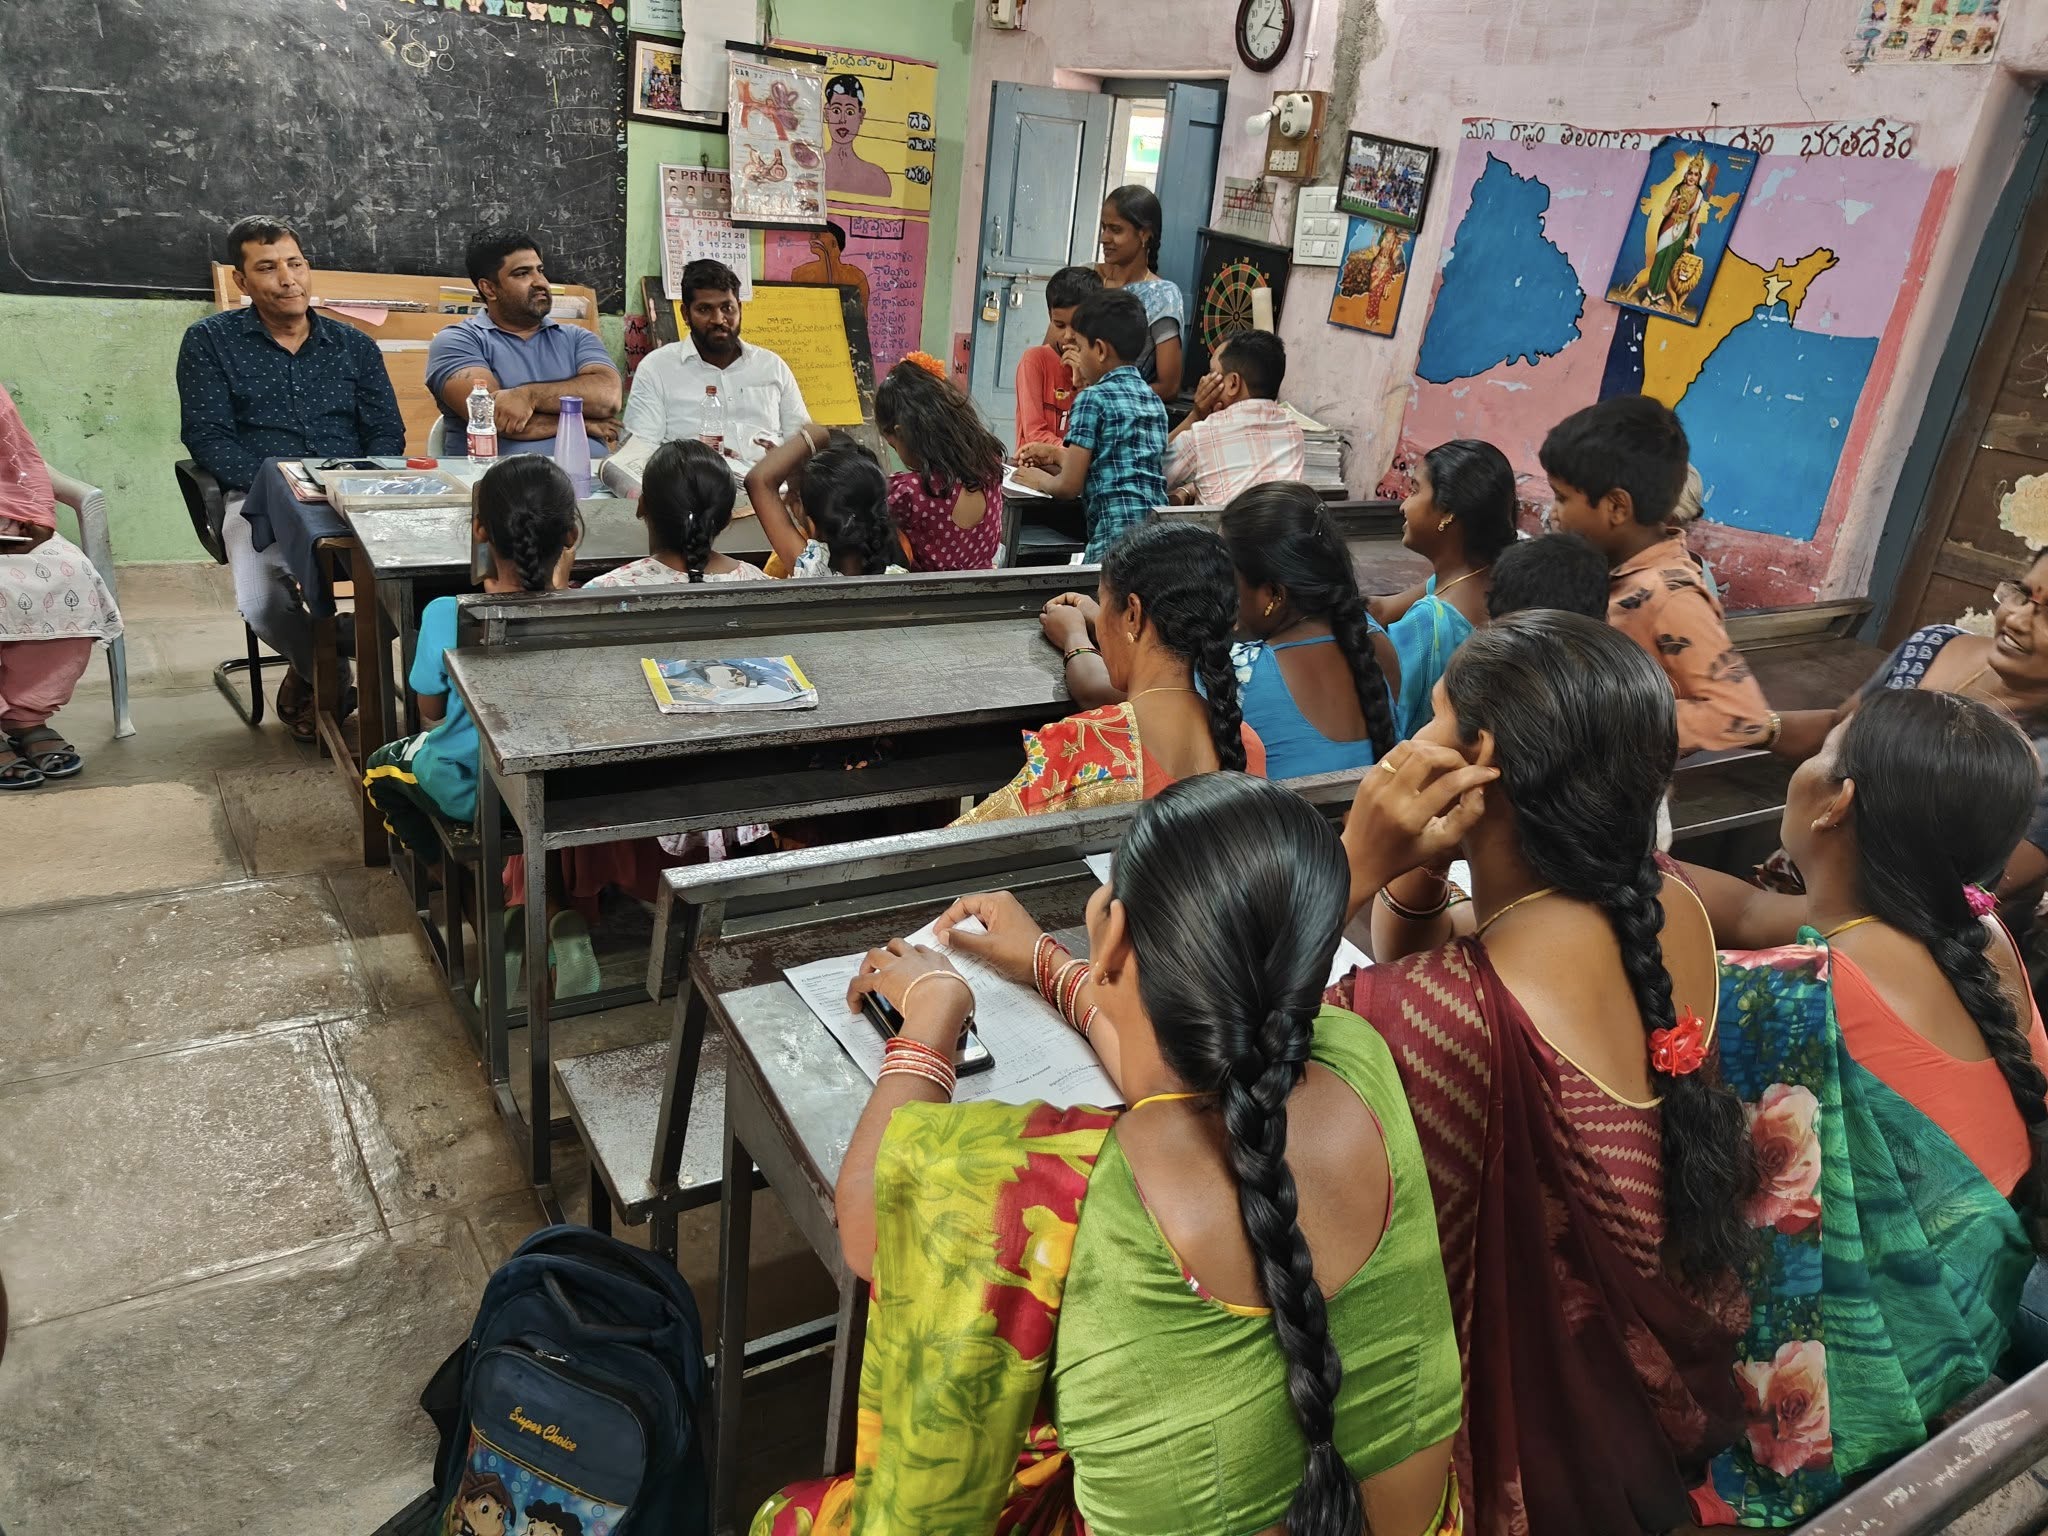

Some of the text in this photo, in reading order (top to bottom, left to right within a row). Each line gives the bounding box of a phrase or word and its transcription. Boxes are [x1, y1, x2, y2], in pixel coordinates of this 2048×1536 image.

[735, 68, 750, 77] EAR
[1466, 122, 1495, 141] మన
[696, 210, 717, 218] 2025
[708, 220, 719, 228] 13
[721, 231, 732, 239] 21
[734, 232, 745, 240] 28
[509, 1407, 578, 1452] Super Choice
